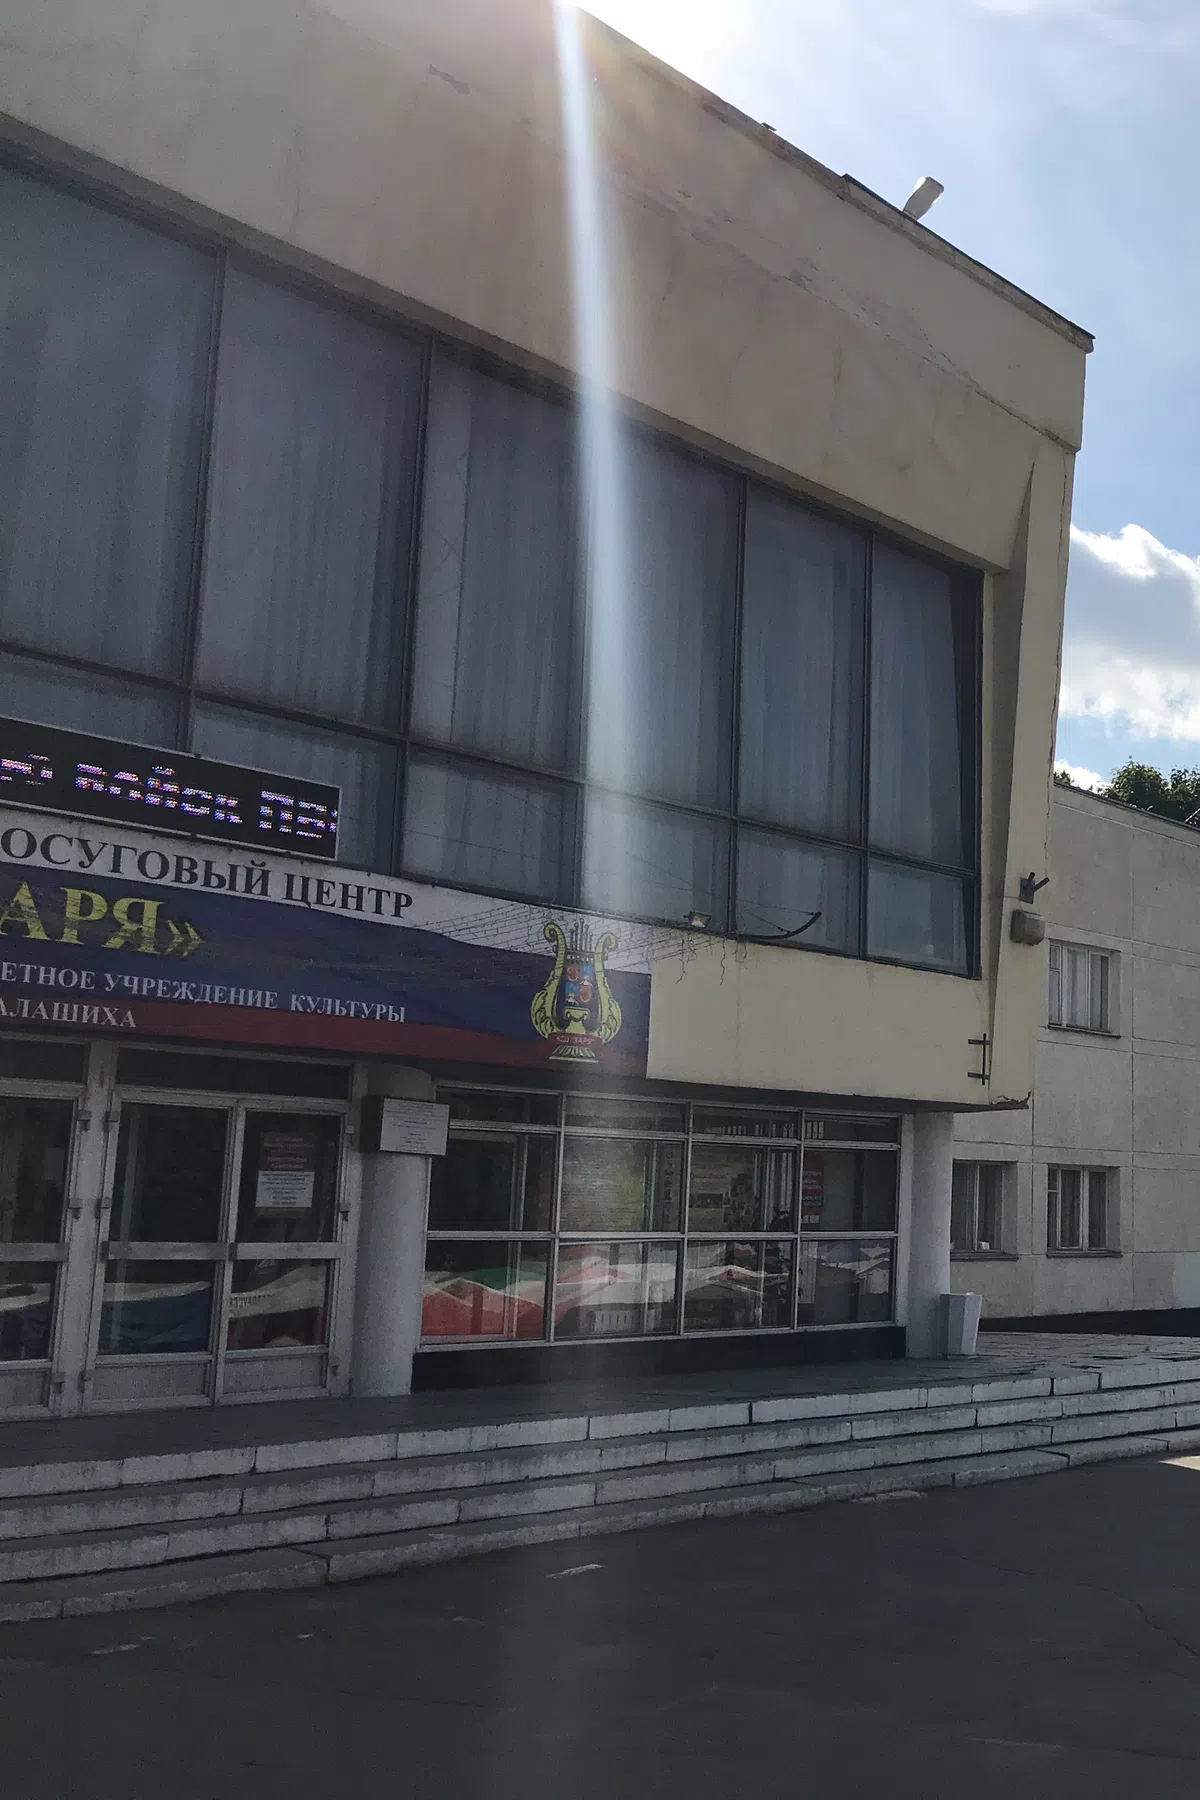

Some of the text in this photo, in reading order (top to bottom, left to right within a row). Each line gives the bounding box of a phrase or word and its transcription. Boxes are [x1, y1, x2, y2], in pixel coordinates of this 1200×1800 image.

[1, 827, 413, 918] ОСУГОВЫЙ ЦЕНТР
[1, 961, 406, 1023] ЕТНОЕ УЧРЕЖДЕНИЕ КУЛЬТУРЫ
